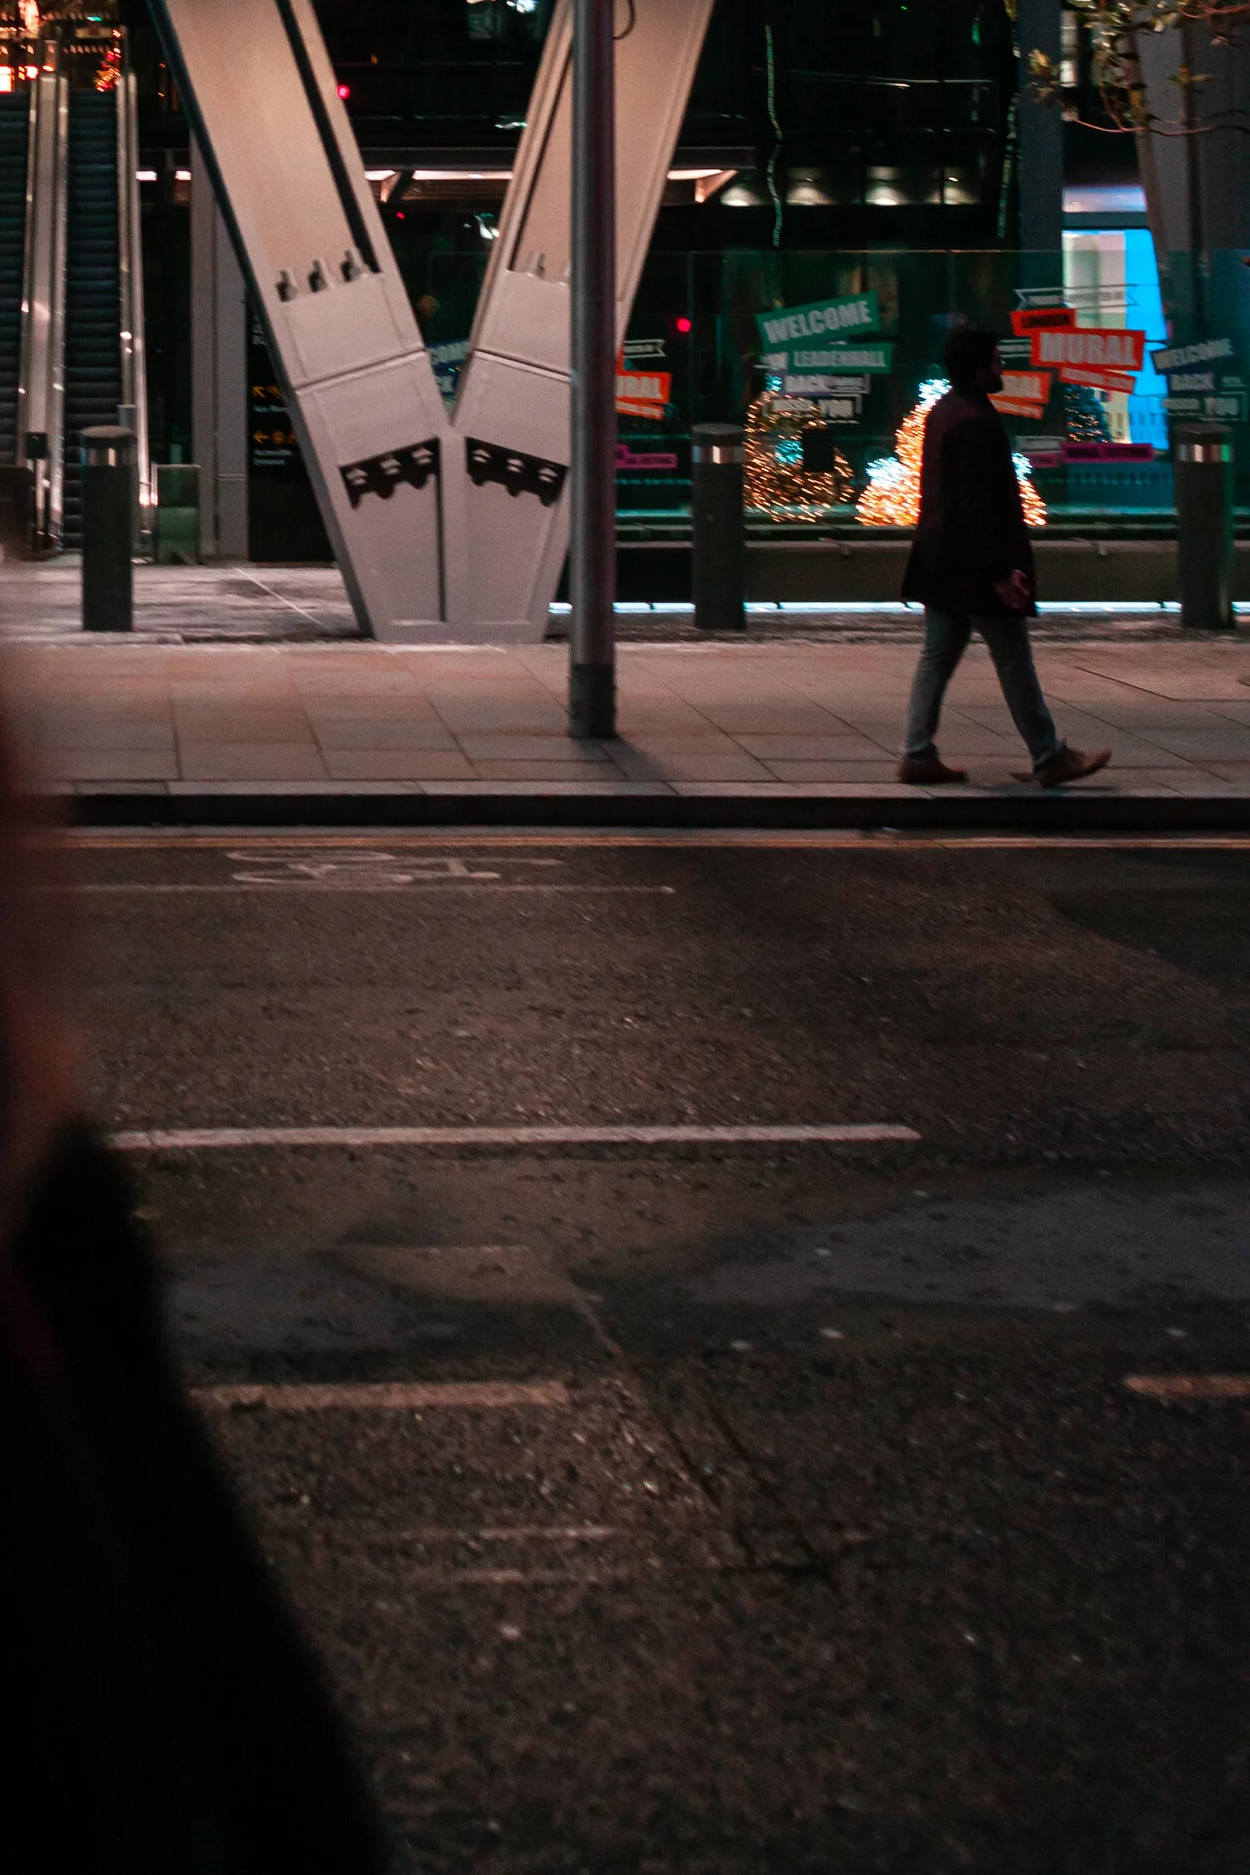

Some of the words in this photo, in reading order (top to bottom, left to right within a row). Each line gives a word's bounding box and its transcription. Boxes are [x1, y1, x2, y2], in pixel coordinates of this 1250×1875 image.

[763, 300, 873, 344] WELCOME
[1040, 332, 1138, 366] MURAL
[1153, 338, 1234, 370] WELCOME
